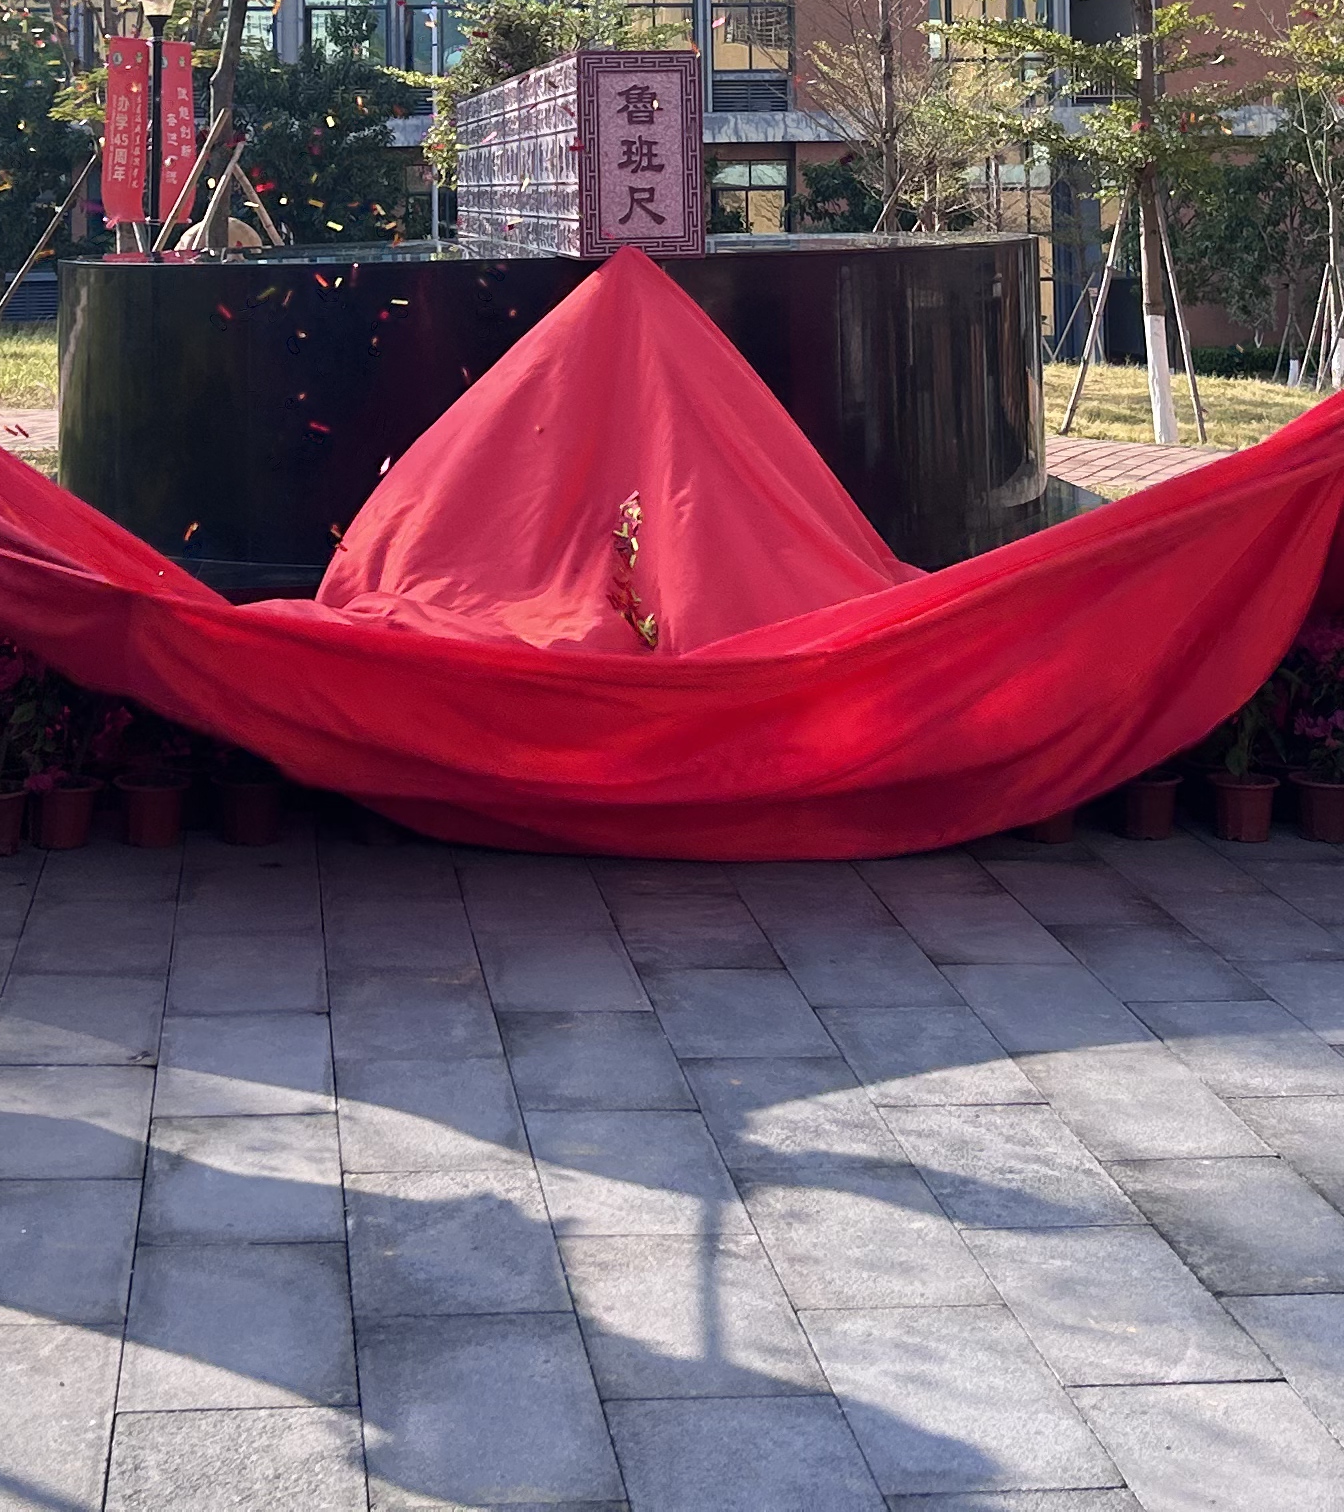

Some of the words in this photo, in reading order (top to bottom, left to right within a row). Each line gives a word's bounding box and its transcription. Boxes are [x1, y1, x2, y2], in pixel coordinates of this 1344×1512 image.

[112, 95, 130, 182] 办学45周年
[616, 83, 667, 226] 魯班尺
